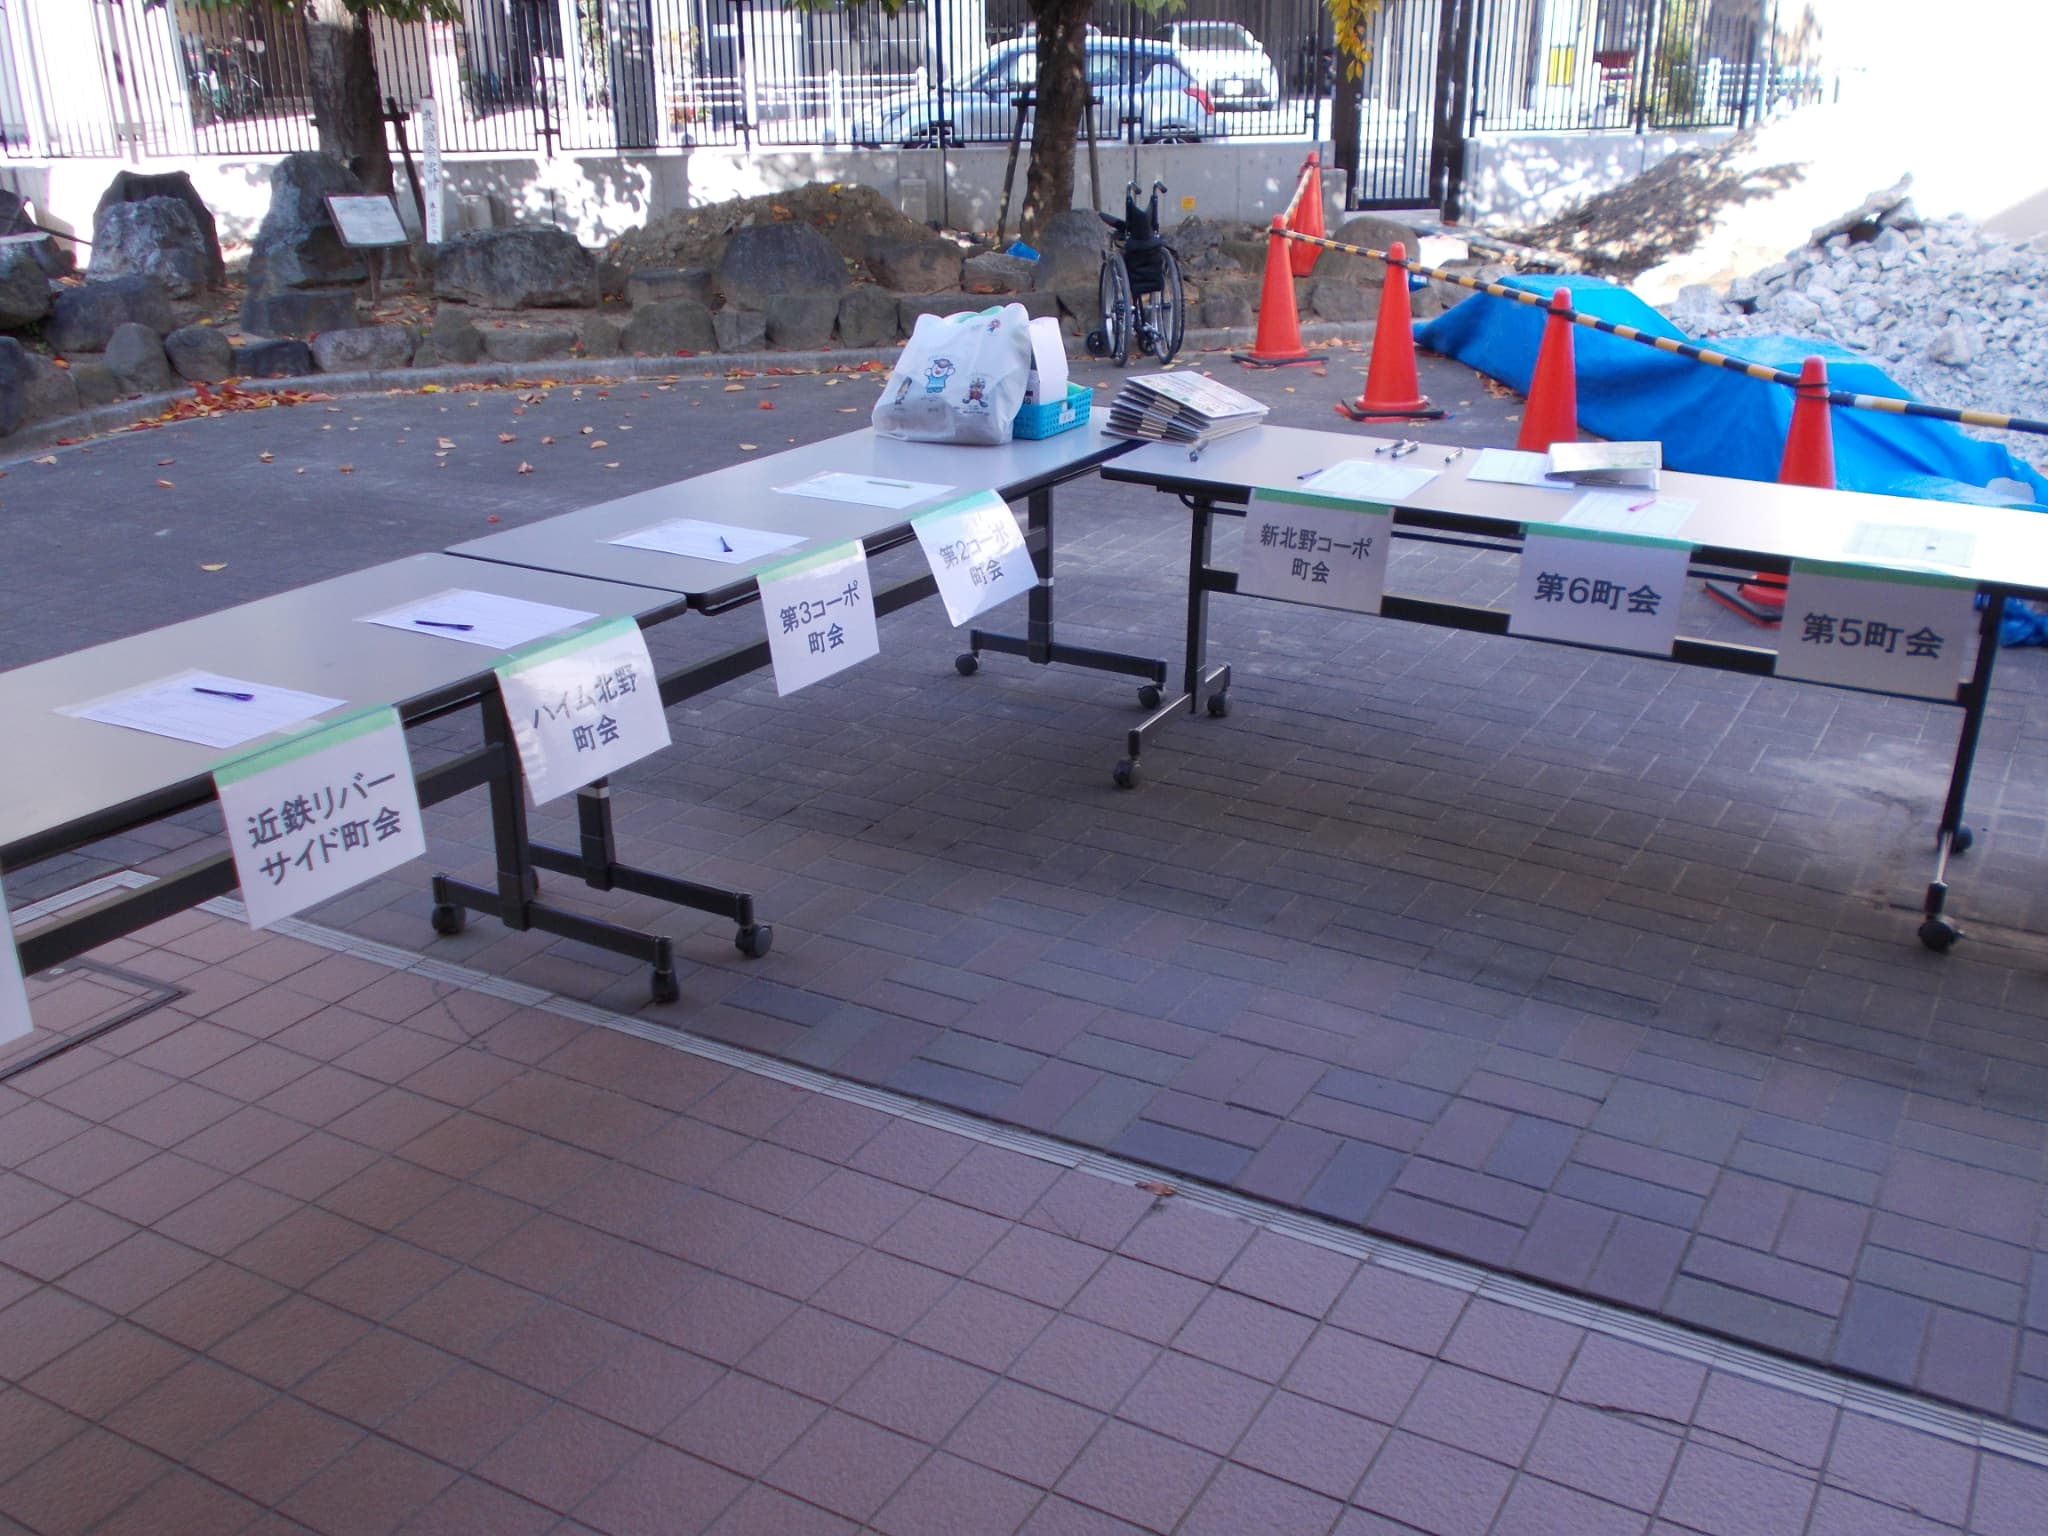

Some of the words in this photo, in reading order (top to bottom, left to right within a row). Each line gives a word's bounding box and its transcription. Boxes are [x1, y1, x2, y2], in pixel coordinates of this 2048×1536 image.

[938, 519, 1010, 569] 第2コーポ
[1260, 523, 1373, 560] 新北野コーポ
[969, 559, 1005, 587] 町会
[1291, 557, 1330, 584] 町会
[1534, 571, 1663, 616] 第6町会
[779, 579, 859, 634] 第3コーポ
[808, 622, 845, 655] 町会
[1801, 612, 1945, 660] 第5町会
[532, 664, 637, 729] ハイム北野
[572, 714, 620, 753] 町会
[248, 771, 396, 849] 近鉄リバー
[259, 806, 402, 887] サイド町会
